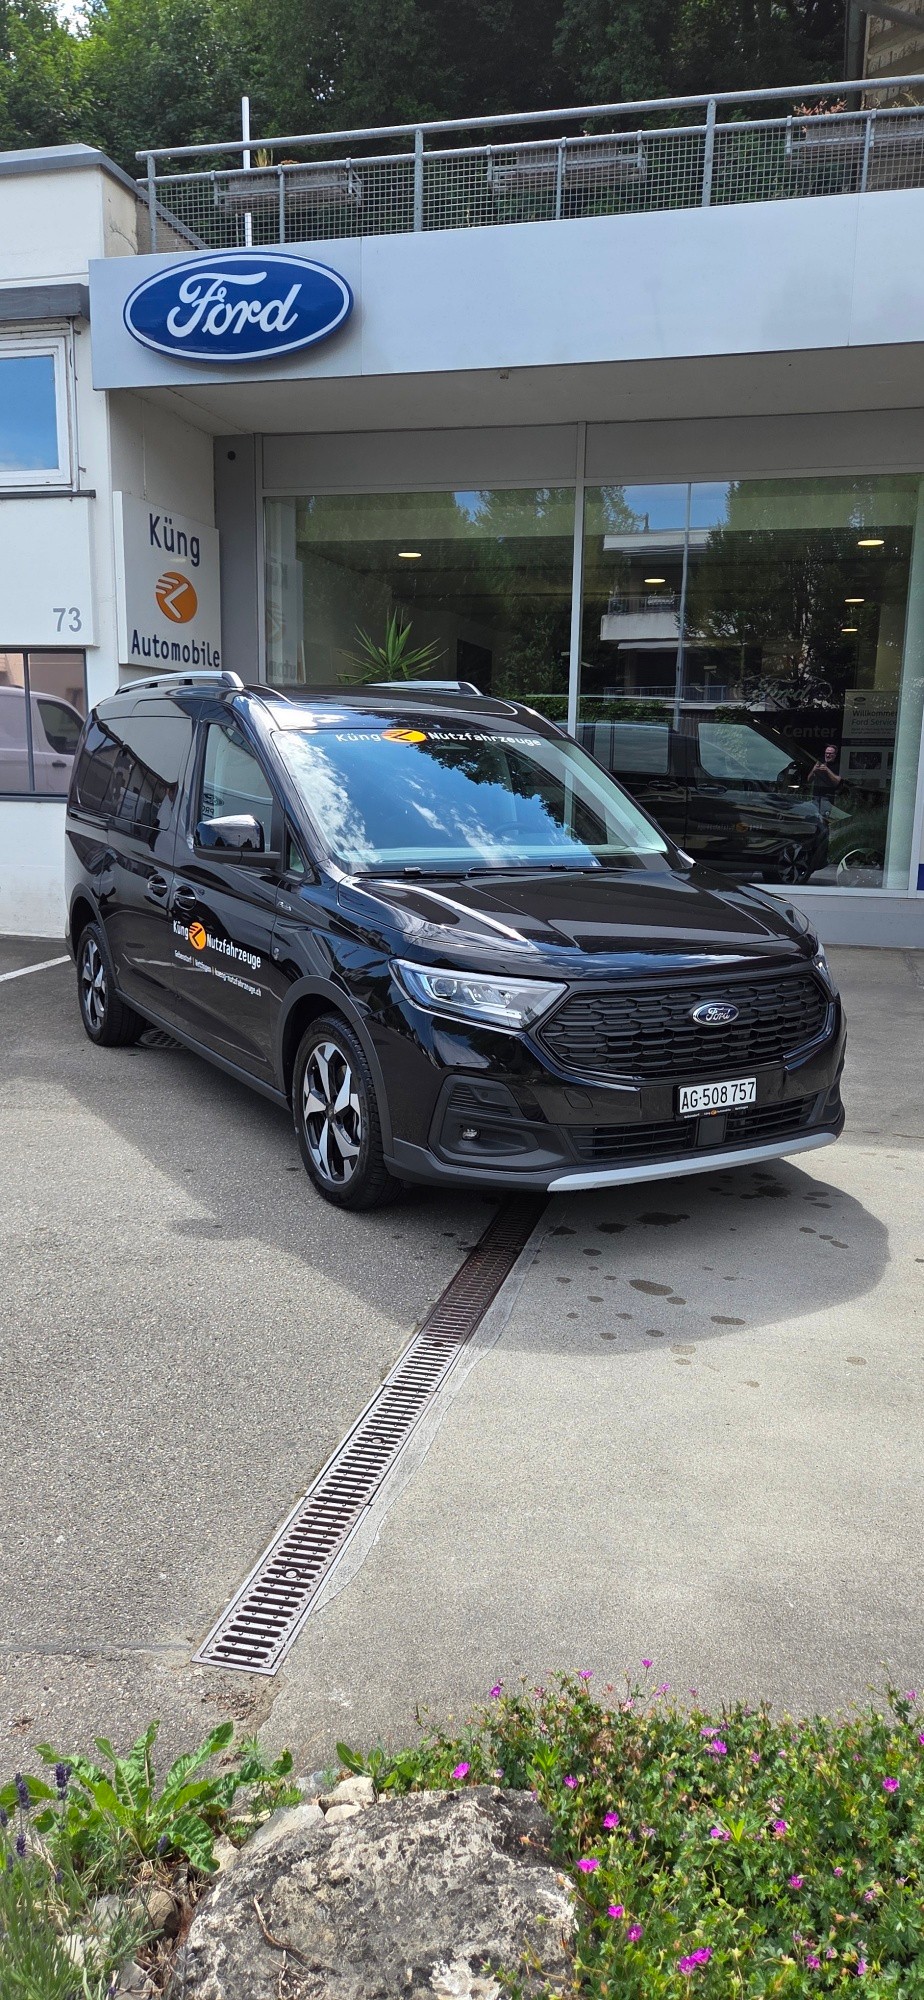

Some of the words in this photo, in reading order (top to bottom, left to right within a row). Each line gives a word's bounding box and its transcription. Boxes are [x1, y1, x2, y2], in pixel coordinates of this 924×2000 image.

[166, 271, 302, 338] Ford
[149, 513, 200, 567] Küng
[53, 607, 82, 632] 73
[132, 629, 220, 668] Automobile
[336, 732, 381, 743] Küng
[427, 732, 542, 747] Nutzfahrzeuge
[783, 725, 837, 738] Center
[173, 920, 189, 940] Küng
[206, 933, 262, 970] Nutzfahrzeuge
[705, 1007, 731, 1021] Ford
